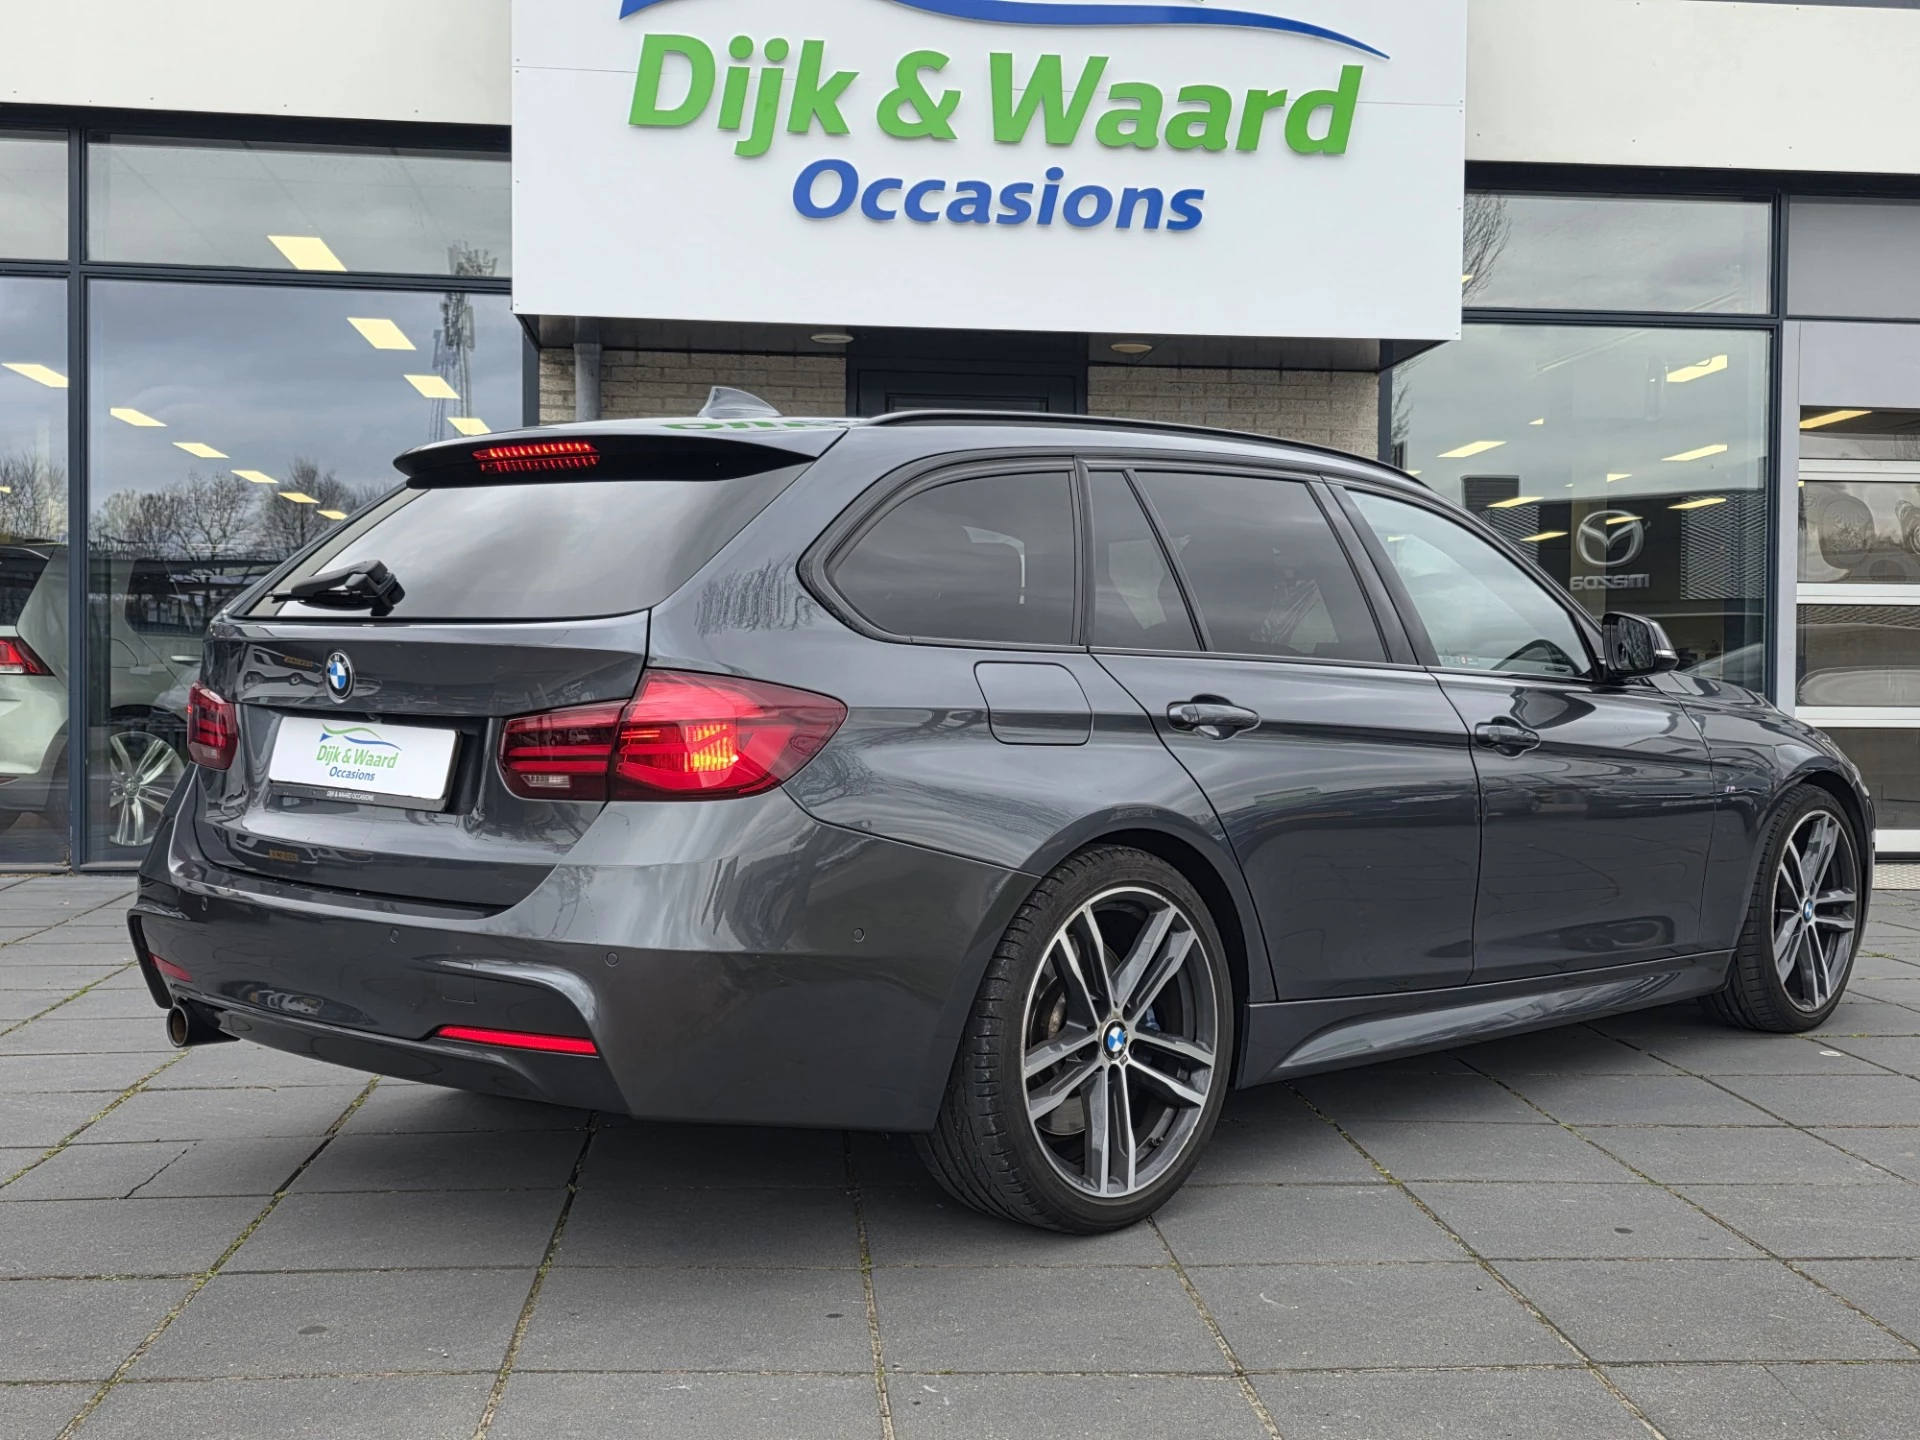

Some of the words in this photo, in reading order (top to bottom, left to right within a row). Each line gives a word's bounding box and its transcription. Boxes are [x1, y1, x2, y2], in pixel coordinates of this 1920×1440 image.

[630, 34, 859, 157] Dijk
[876, 50, 961, 140] &
[989, 52, 1364, 155] Waard
[792, 158, 1206, 232] Occasions
[316, 745, 341, 766] Dijk
[341, 748, 352, 764] &
[353, 748, 399, 768] Waard
[329, 766, 376, 781] Occasions
